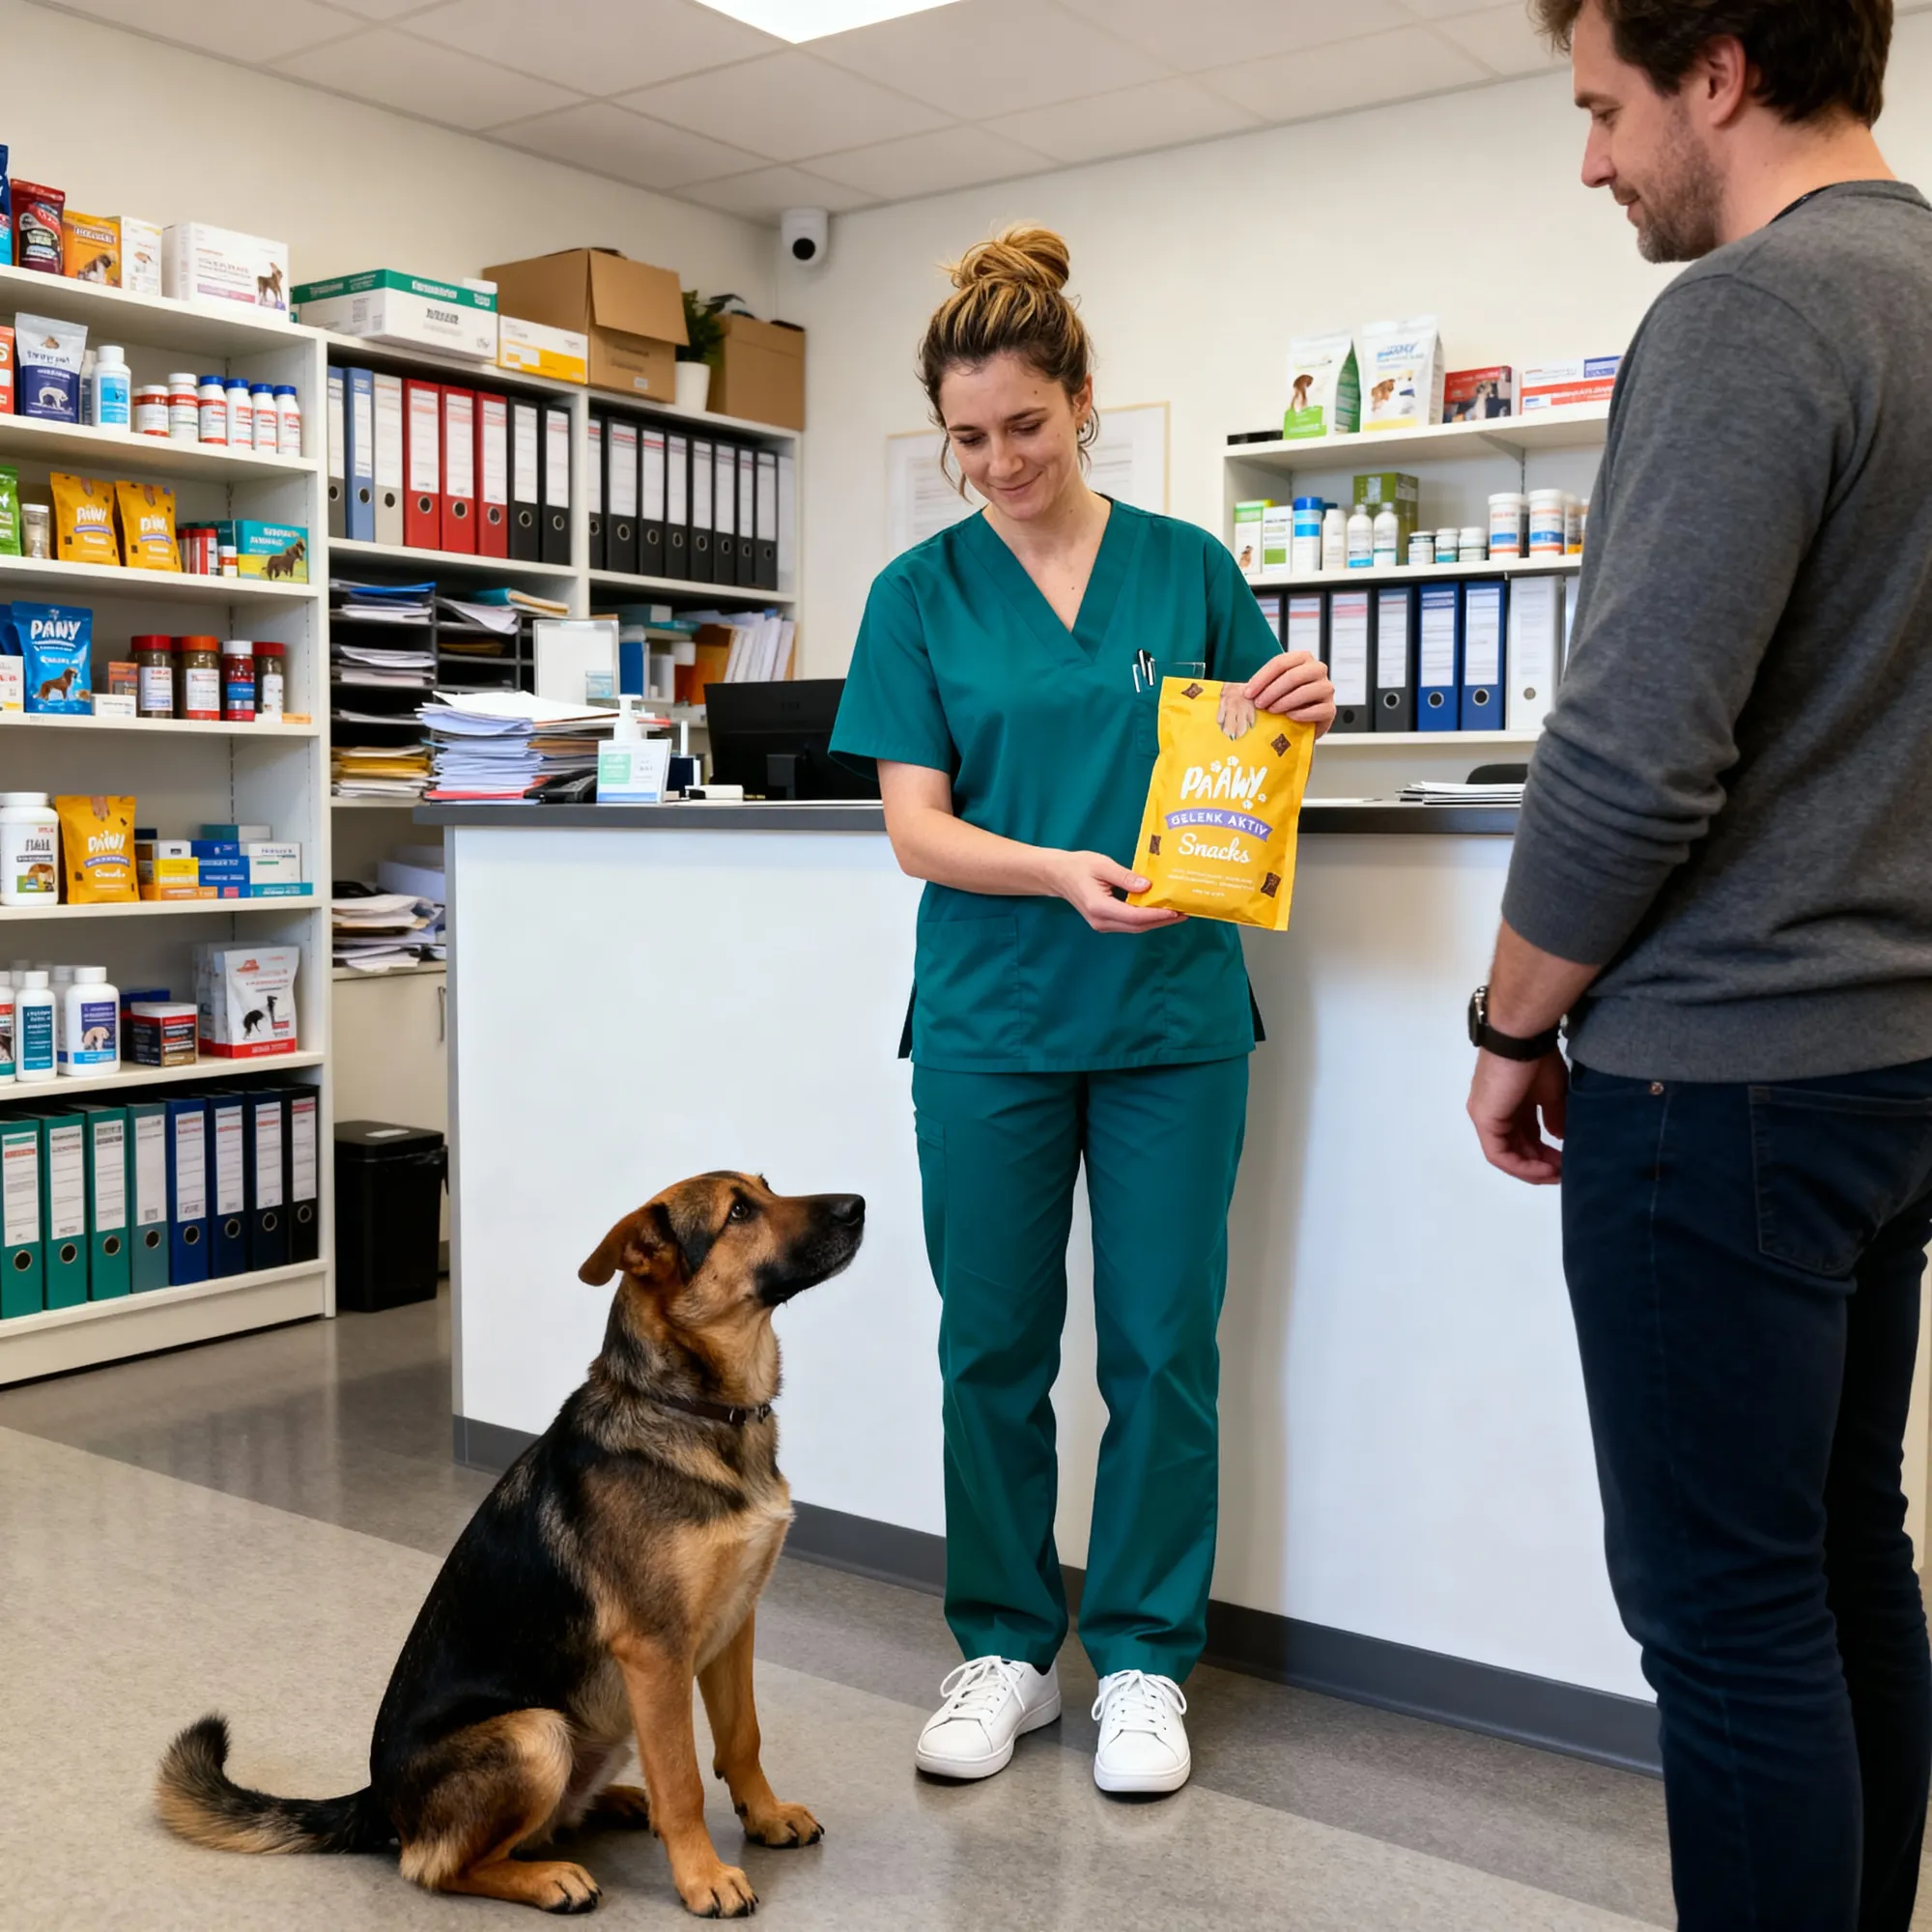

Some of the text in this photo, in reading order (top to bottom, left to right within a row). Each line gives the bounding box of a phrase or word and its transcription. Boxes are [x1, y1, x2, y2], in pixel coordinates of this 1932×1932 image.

[1171, 811, 1268, 836] GELENK AKTIV
[1178, 833, 1250, 863] Snacks
